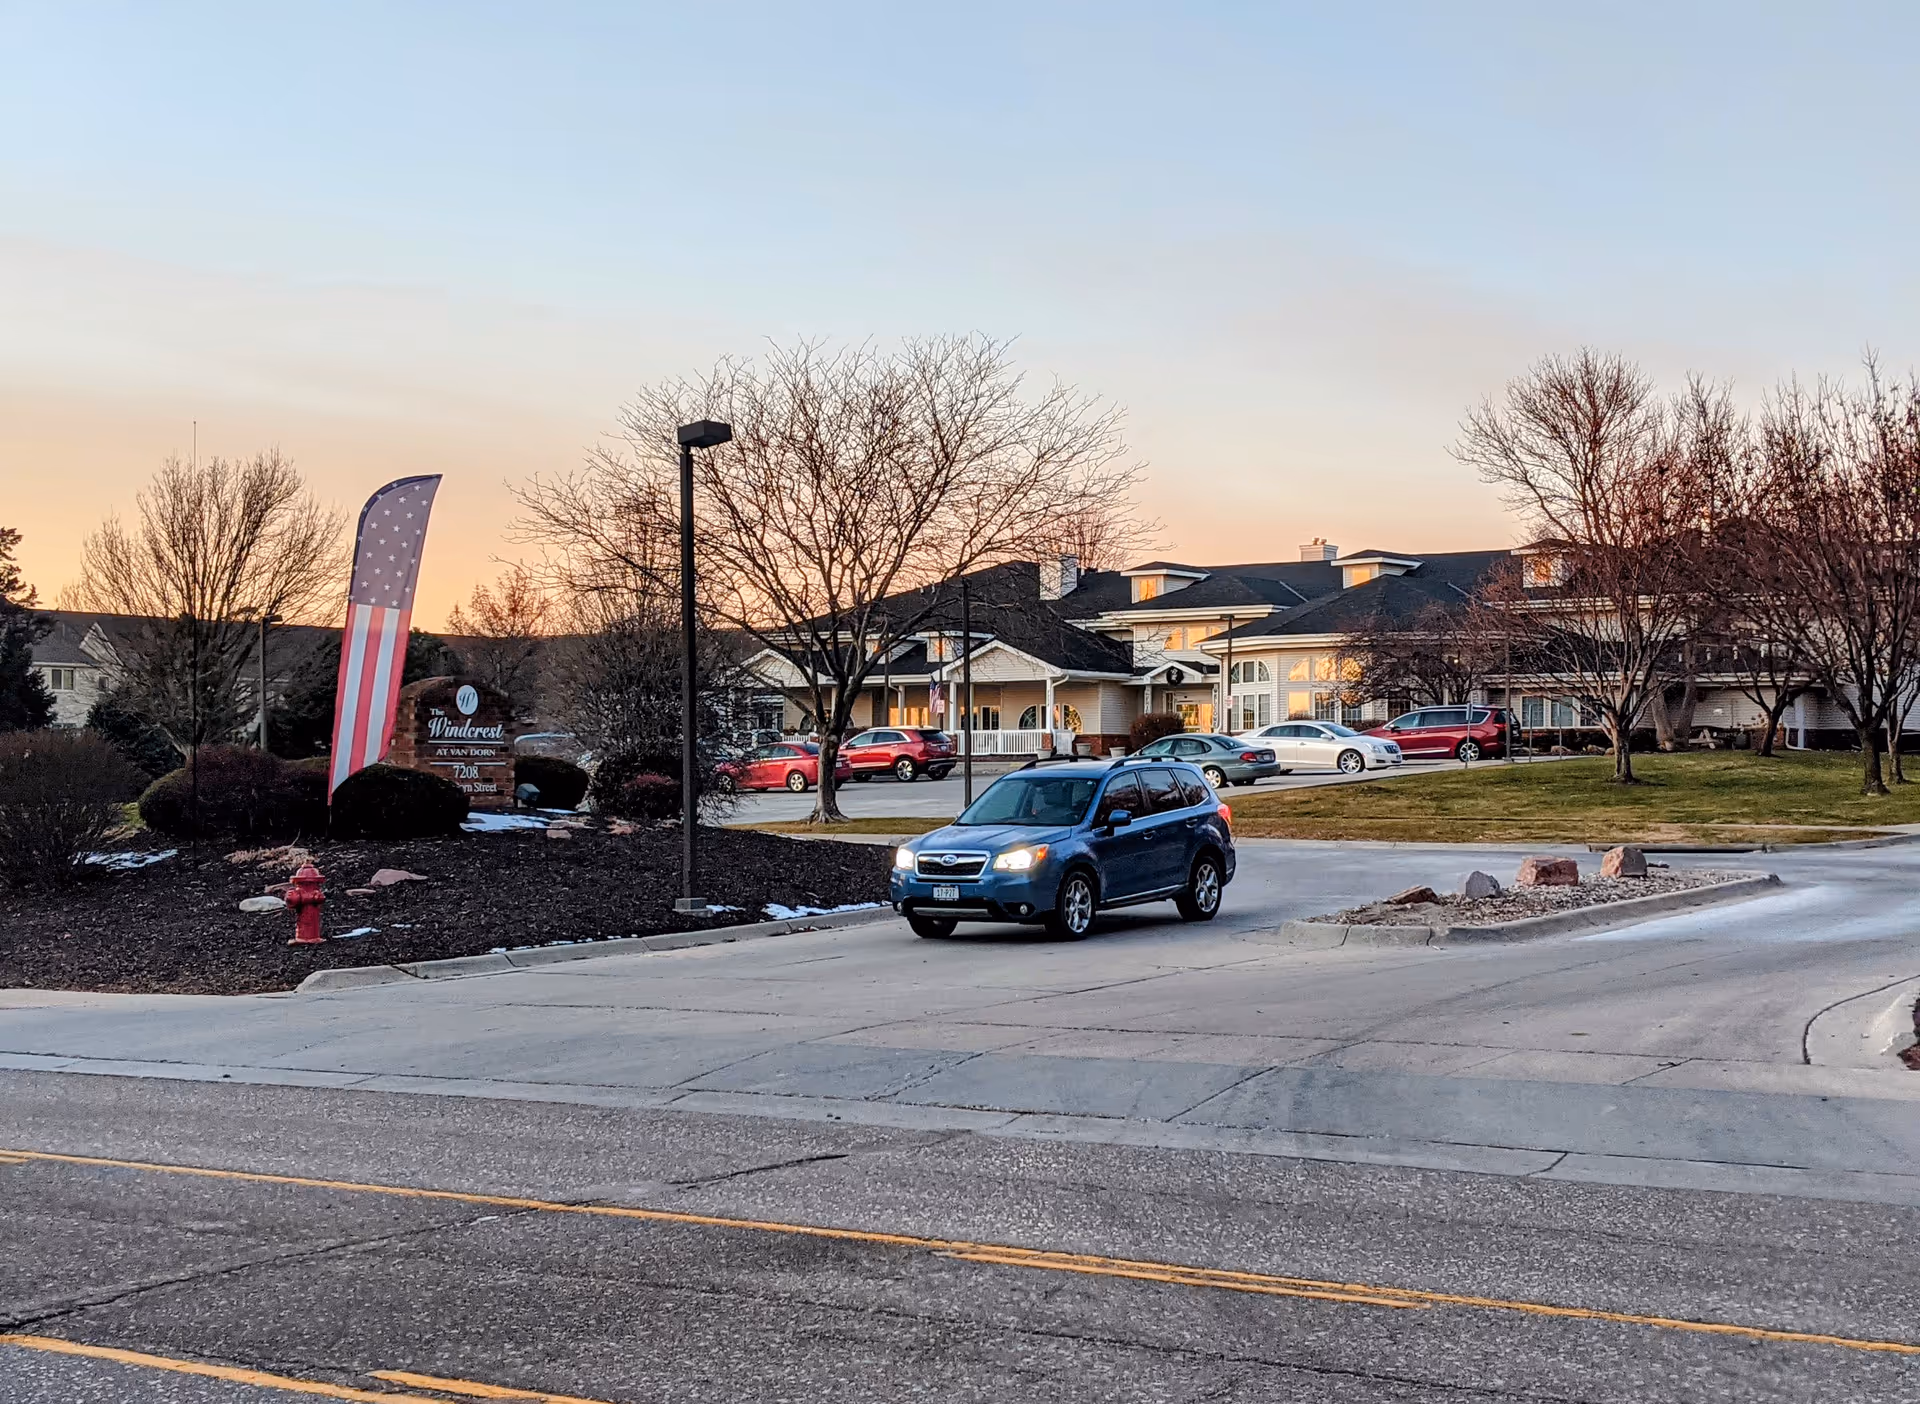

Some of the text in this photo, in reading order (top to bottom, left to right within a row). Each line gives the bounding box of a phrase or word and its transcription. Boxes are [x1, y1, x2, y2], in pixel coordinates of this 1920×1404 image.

[430, 708, 445, 716] The
[428, 717, 504, 739] Windcrest
[436, 748, 496, 756] AT VAN DORN
[453, 765, 479, 779] 7208
[473, 782, 497, 793] Street
